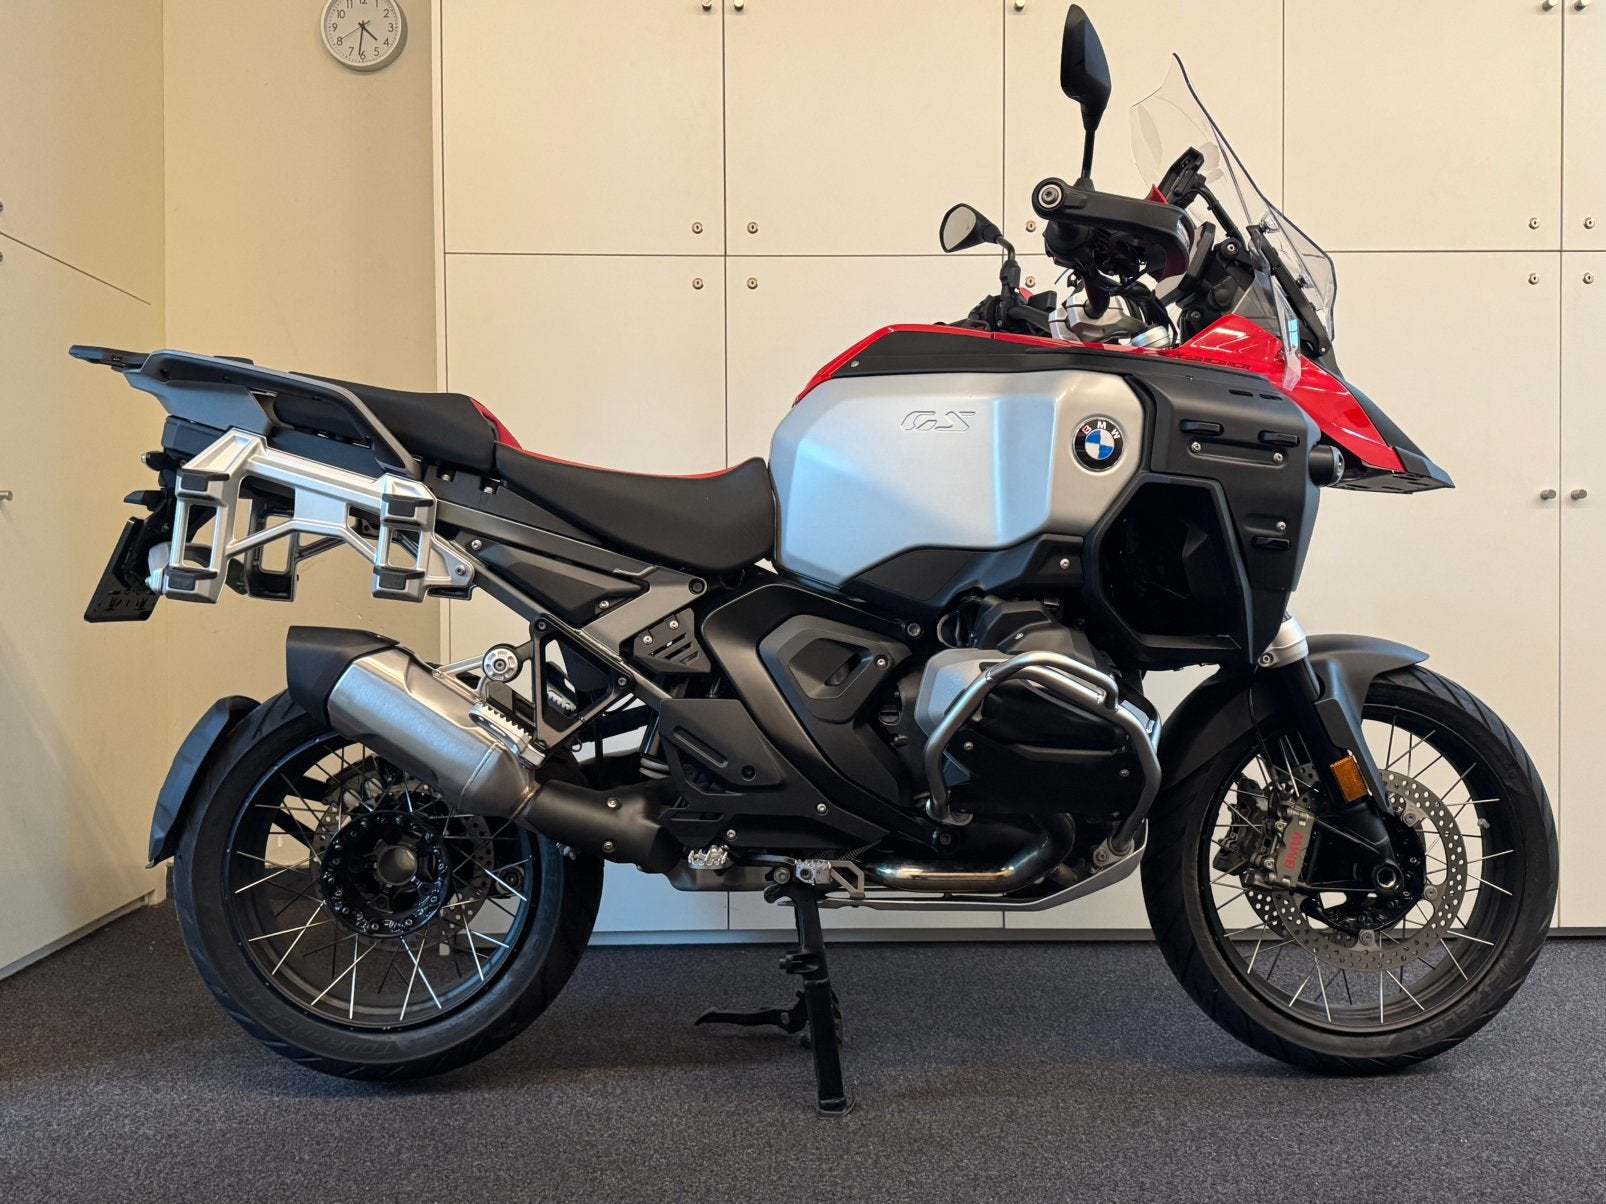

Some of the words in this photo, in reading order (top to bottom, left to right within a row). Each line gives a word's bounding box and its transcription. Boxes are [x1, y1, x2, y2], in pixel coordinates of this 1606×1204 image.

[336, 9, 346, 19] 10
[383, 8, 390, 18] 2
[331, 22, 338, 32] 9
[387, 22, 394, 32] 3
[336, 36, 343, 46] 8
[383, 37, 390, 47] 4
[348, 46, 355, 56] 7
[360, 50, 366, 60] 6
[373, 46, 380, 57] 5
[900, 410, 976, 431] GS
[1081, 420, 1121, 439] BMW
[1283, 831, 1304, 870] BMW
